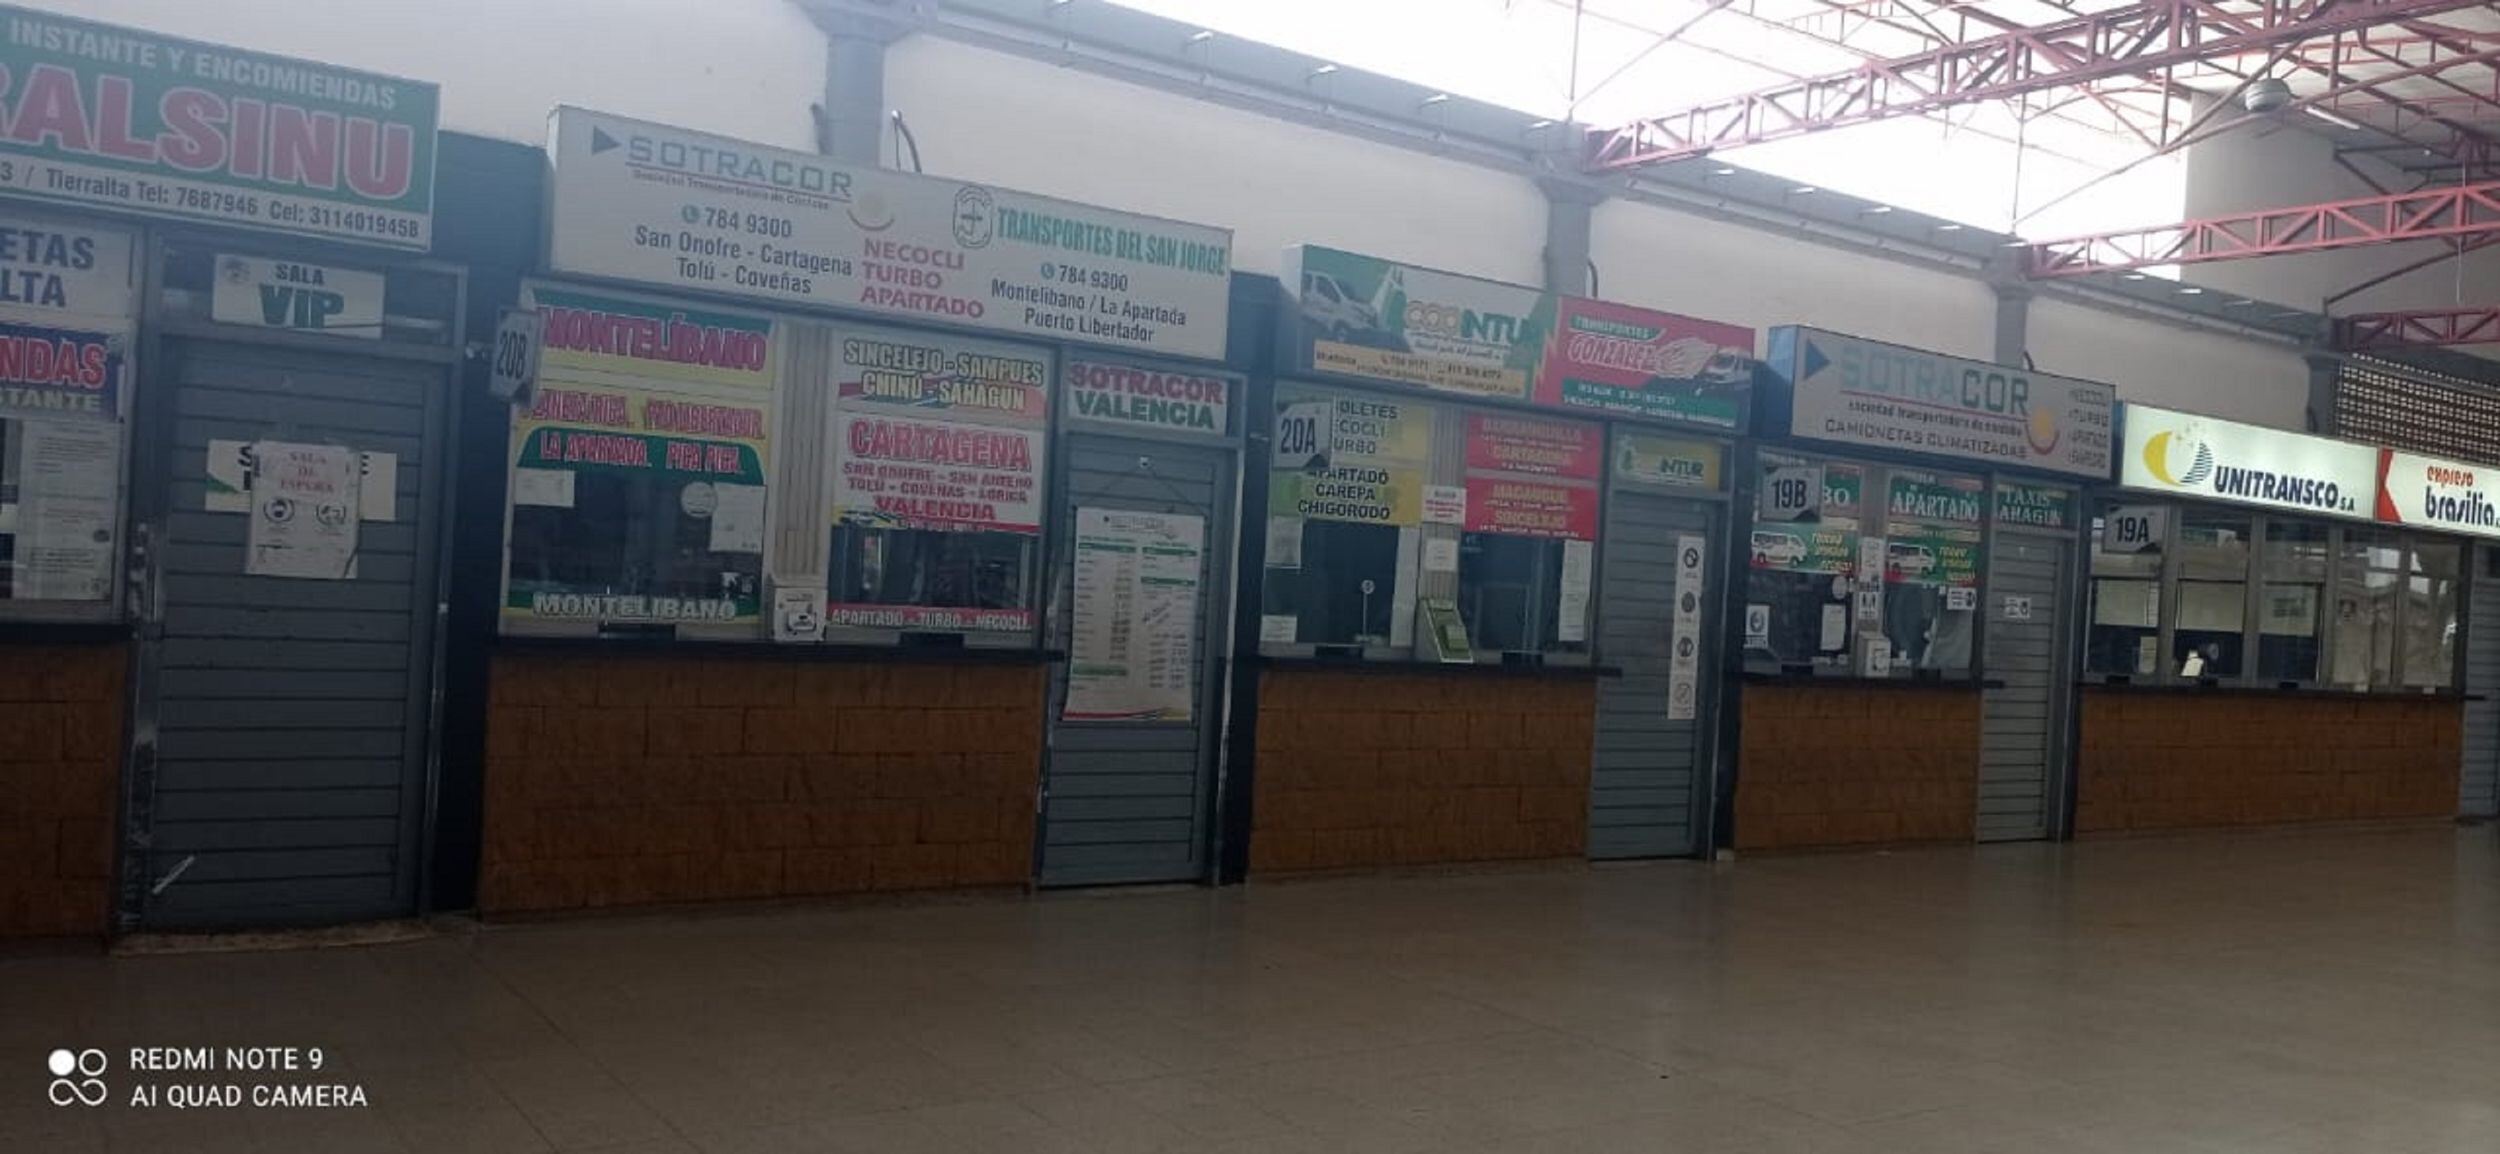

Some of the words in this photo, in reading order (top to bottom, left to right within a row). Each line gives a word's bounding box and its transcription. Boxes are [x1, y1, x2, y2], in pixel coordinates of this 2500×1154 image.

[11, 17, 158, 69] INSTANTE
[167, 47, 186, 71] Y
[194, 52, 397, 111] ENCOMIENDAS
[0, 62, 414, 200] ALSINU
[628, 134, 853, 198] SOTRACOR
[46, 166, 131, 198] Tierralta
[136, 180, 171, 204] Tel:
[175, 186, 259, 217] 7687946
[269, 191, 305, 222] Cel:
[704, 206, 739, 231] 784
[746, 212, 793, 239] 9300
[997, 206, 1114, 258] TRANSPORTES
[1116, 221, 1144, 260] DEL
[1146, 227, 1177, 268] SAN
[634, 224, 672, 249] San
[678, 230, 742, 260] Onofre
[760, 244, 852, 278] Cartagena
[274, 262, 325, 287] SALA
[676, 255, 715, 282] Tolú
[735, 263, 812, 295] Coveñas
[862, 261, 943, 291] TURBO
[1058, 263, 1088, 285] 784
[1091, 268, 1129, 293] 9300
[257, 281, 346, 329] VIP
[860, 285, 986, 319] APARTADO
[1099, 299, 1119, 317] La
[1121, 299, 1188, 327] Apartada
[1024, 306, 1075, 332] Puerto
[1078, 315, 1154, 343] Libertador
[495, 328, 529, 381] 20B
[843, 337, 945, 374] SINCELEJO
[956, 350, 1044, 386] SAMPUES
[1070, 363, 1224, 405] SOTRACOR
[1838, 343, 2030, 415] SOTRACOR
[1075, 390, 1215, 430] VALENCIA
[849, 417, 1032, 472] CARTAGENA
[1280, 416, 1318, 455] 20A
[1824, 417, 1924, 446] CAMIONETAS
[843, 461, 875, 475] SAN
[2212, 464, 2340, 510] UNITRANSCO
[873, 495, 996, 520] VALENCIA
[1315, 482, 1377, 501] CAREPA
[1772, 477, 1808, 509] 19B
[2116, 515, 2151, 544] 19A
